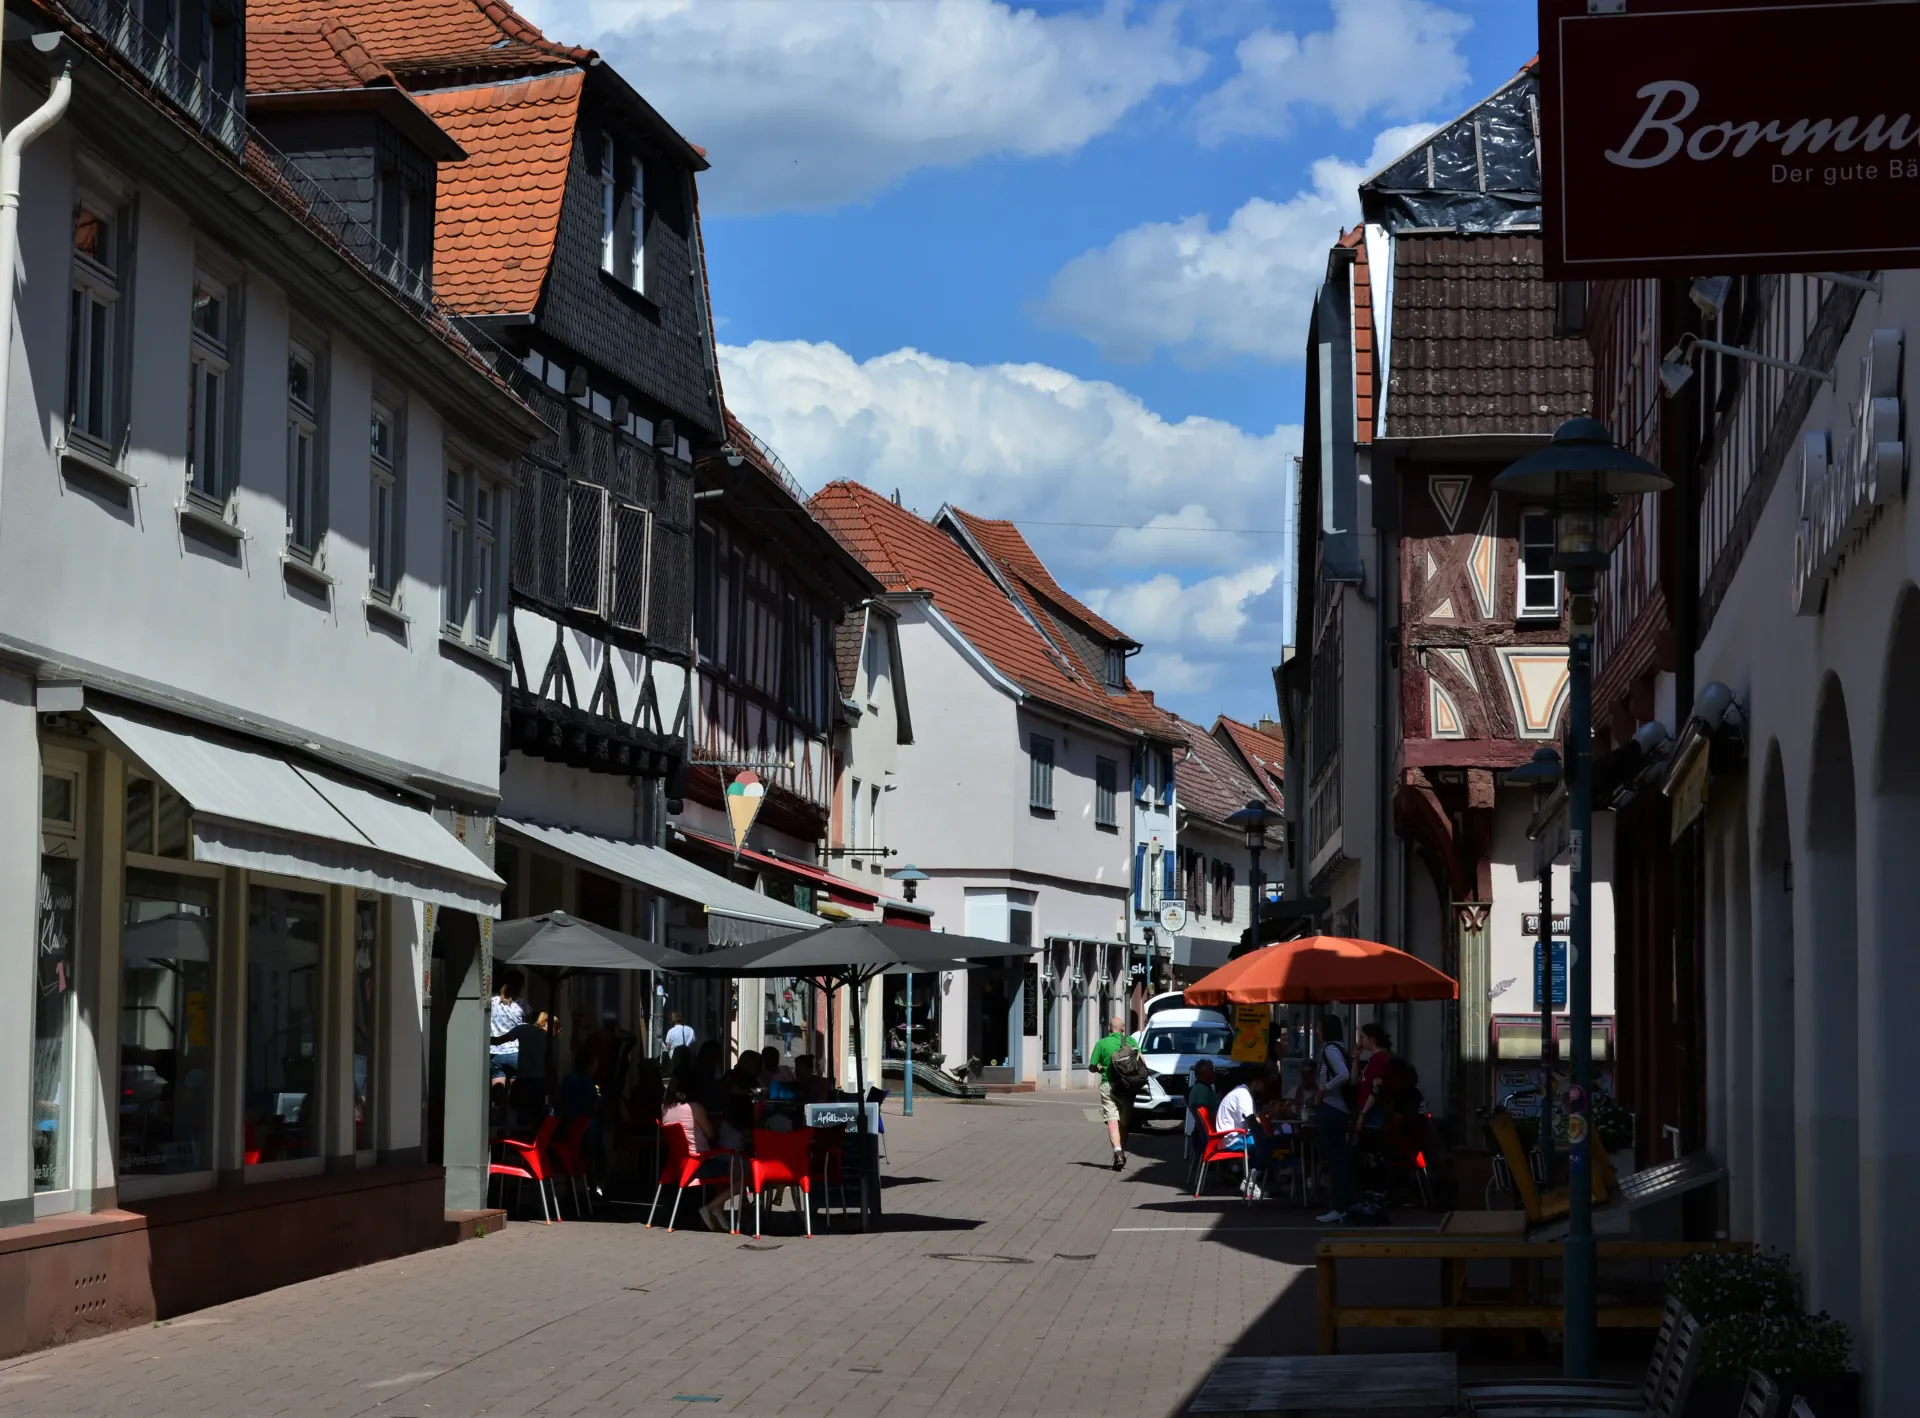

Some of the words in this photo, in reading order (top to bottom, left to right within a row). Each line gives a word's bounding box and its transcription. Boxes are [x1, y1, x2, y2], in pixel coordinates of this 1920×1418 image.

[1604, 79, 1920, 169] Bormu
[1771, 163, 1814, 184] Der
[1823, 163, 1879, 186] gute
[1889, 157, 1918, 179] Bä
